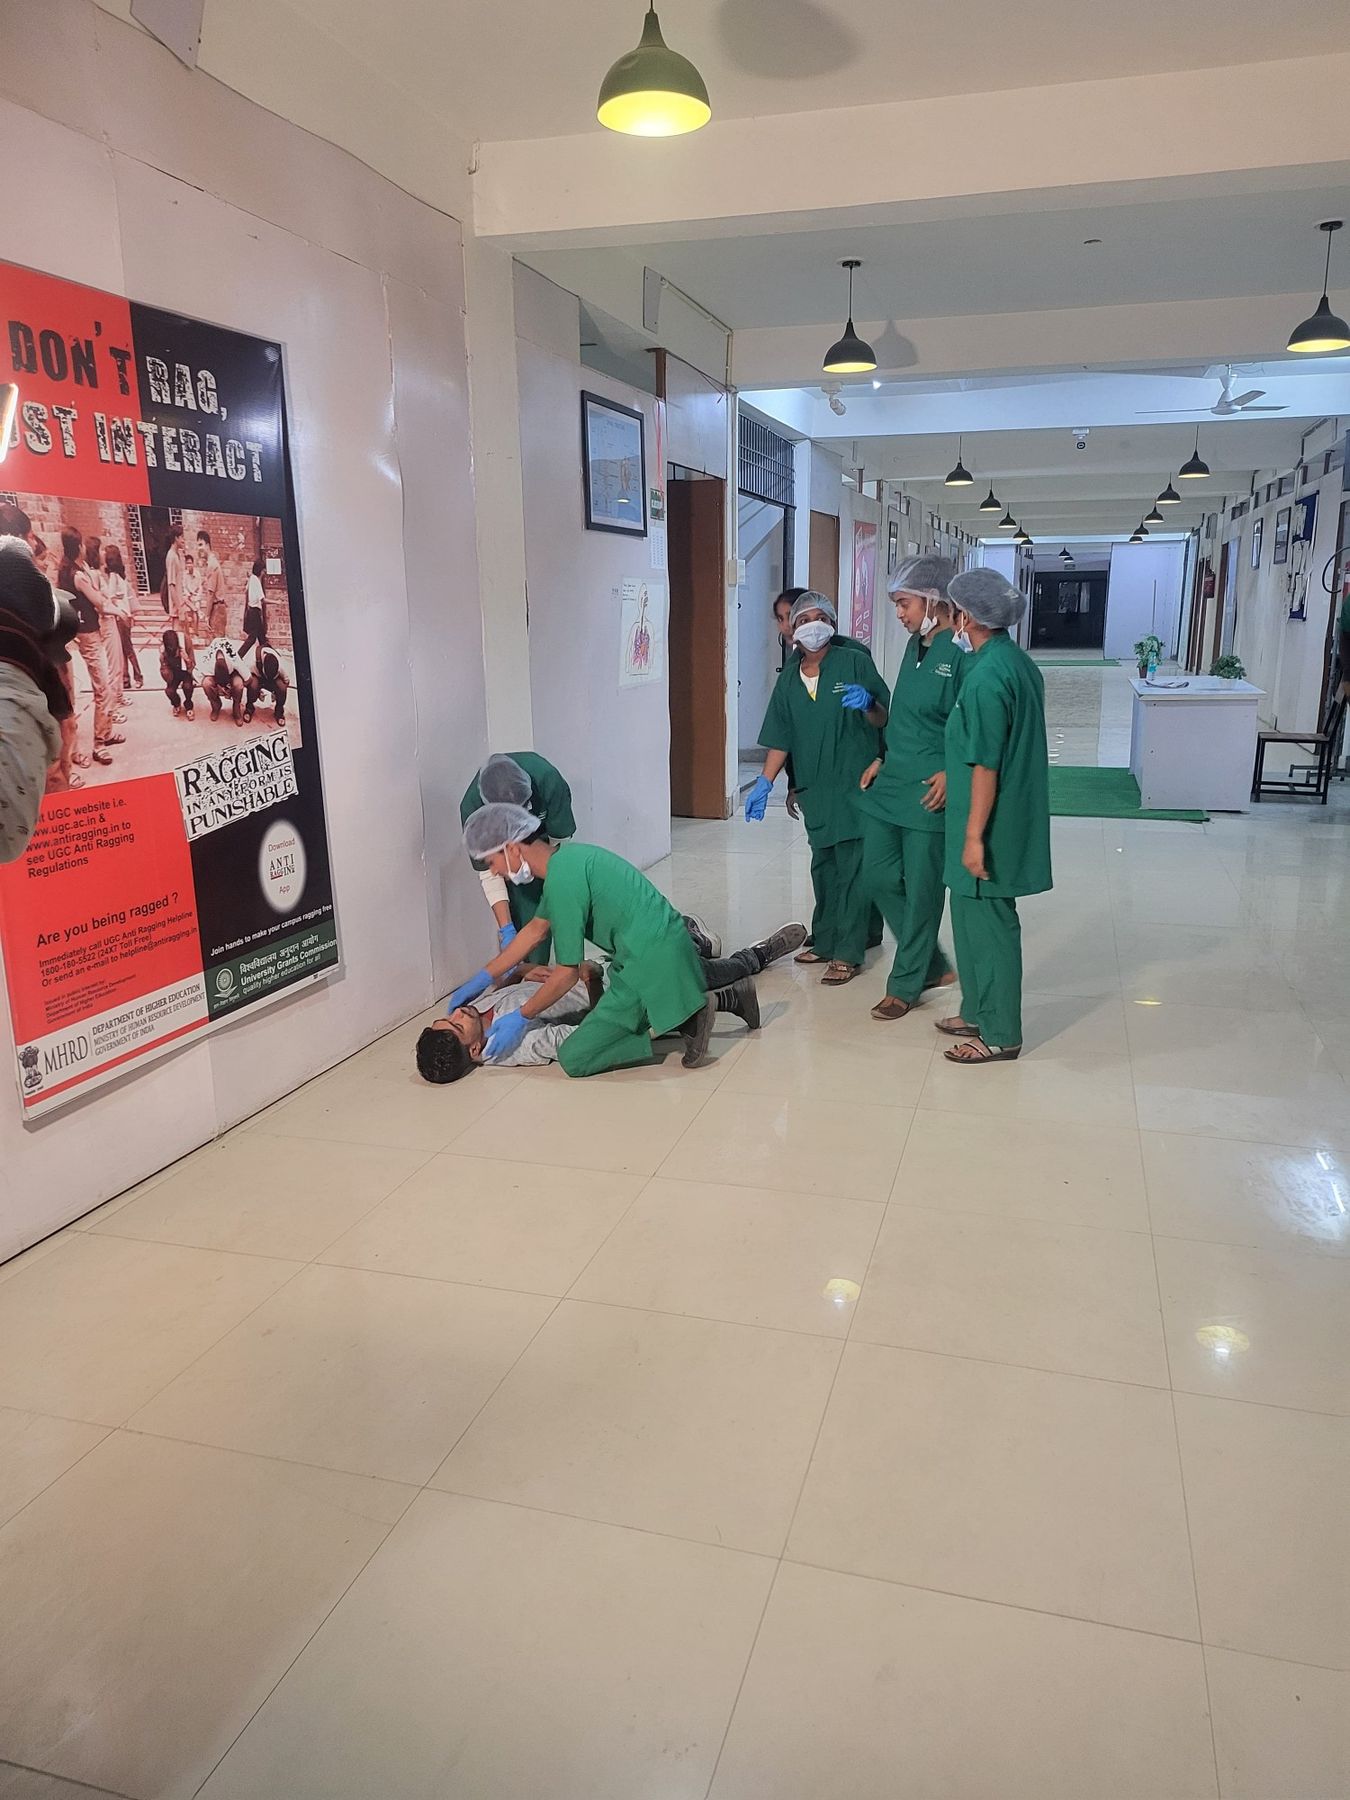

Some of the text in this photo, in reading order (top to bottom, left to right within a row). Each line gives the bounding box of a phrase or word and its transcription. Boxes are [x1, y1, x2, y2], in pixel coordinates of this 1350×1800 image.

[8, 320, 228, 421] DON'T RAG,
[9, 400, 263, 482] ST INTERACT
[183, 736, 288, 797] RAGGING
[47, 807, 71, 821] UGC
[73, 800, 111, 816] website
[112, 798, 126, 808] i.e.
[187, 765, 292, 815] IN ANY FORM IS
[190, 777, 295, 835] PUNISHABLE
[33, 816, 96, 838] ww.ugc.ac.in
[98, 813, 106, 823] &
[122, 821, 131, 830] to
[268, 837, 295, 852] Download
[26, 832, 135, 866] see UGC Anti Ragging
[28, 856, 89, 878] Regulations
[270, 853, 294, 871] ANTI
[279, 885, 290, 894] App
[37, 892, 179, 948] Are you being ragged ?
[39, 911, 193, 968] Immediately call UGC Anti Ragging Helpline
[210, 904, 332, 957] Join hands to make your campus ragging free
[41, 952, 96, 977] 1800-180-5522
[119, 939, 133, 950] Toll
[41, 978, 52, 988] Or
[54, 969, 74, 984] send
[75, 967, 85, 977] an
[86, 958, 110, 972] e-mail
[111, 954, 118, 963] to
[239, 934, 319, 975] विश्वविद्यालय अनुदान आयोग
[240, 939, 338, 986] University Grants Commission
[242, 981, 262, 995] quality
[262, 972, 280, 986] higher
[280, 961, 306, 976] education
[92, 1010, 134, 1035] DEPARTMENT
[135, 1006, 144, 1017] OF
[145, 997, 167, 1013] HIGHER
[168, 983, 201, 1003] EDUCATION
[93, 1029, 120, 1046] MINISTRY
[120, 1024, 128, 1034] OF
[128, 1018, 148, 1032] HUMAN
[148, 1008, 173, 1026] RESOURCE
[172, 992, 205, 1015] DEVELOPMENT
[44, 1035, 89, 1075] MHRD
[94, 1024, 155, 1056] GOVERNMENT OF INDIA
